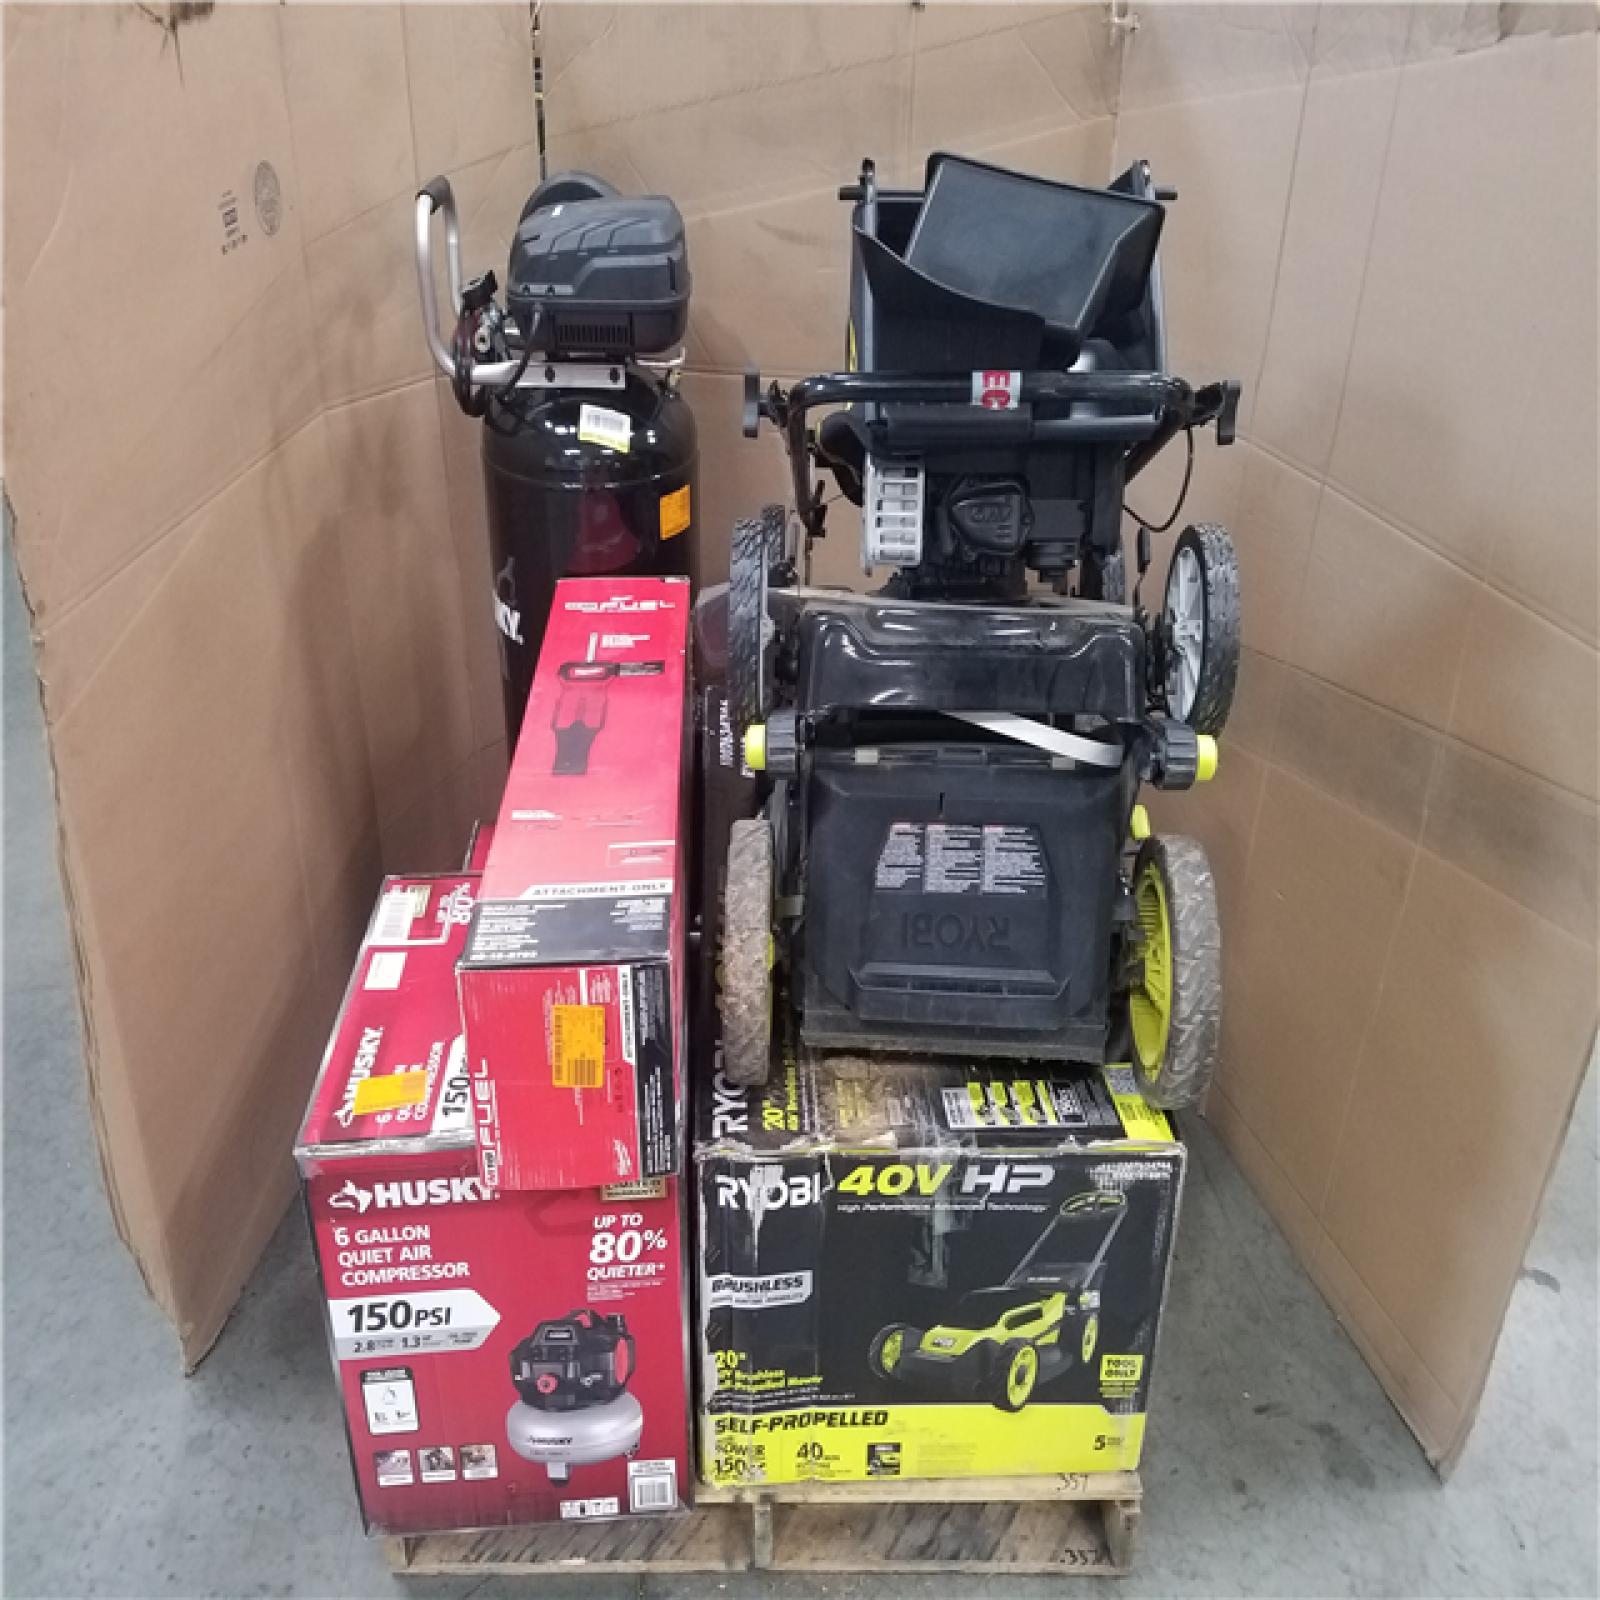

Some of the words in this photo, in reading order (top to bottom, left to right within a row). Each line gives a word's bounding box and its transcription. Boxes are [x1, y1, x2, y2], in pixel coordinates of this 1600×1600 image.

[442, 1077, 471, 1118] 150
[475, 1058, 496, 1146] FUEL
[837, 1164, 953, 1196] 40V
[961, 1164, 1055, 1193] HP
[593, 1215, 616, 1229] UP
[620, 1213, 643, 1227] TO
[333, 1226, 350, 1246] 6
[354, 1224, 431, 1243] GALLON
[589, 1228, 668, 1264] 80%
[337, 1247, 393, 1267] QUIET
[399, 1244, 432, 1260] AIR
[341, 1262, 471, 1286] COMPRESSOR
[347, 1300, 412, 1333] 150
[414, 1306, 452, 1328] PSI
[714, 1409, 889, 1436] SELF-PROPELLED
[797, 1441, 823, 1461] 40
